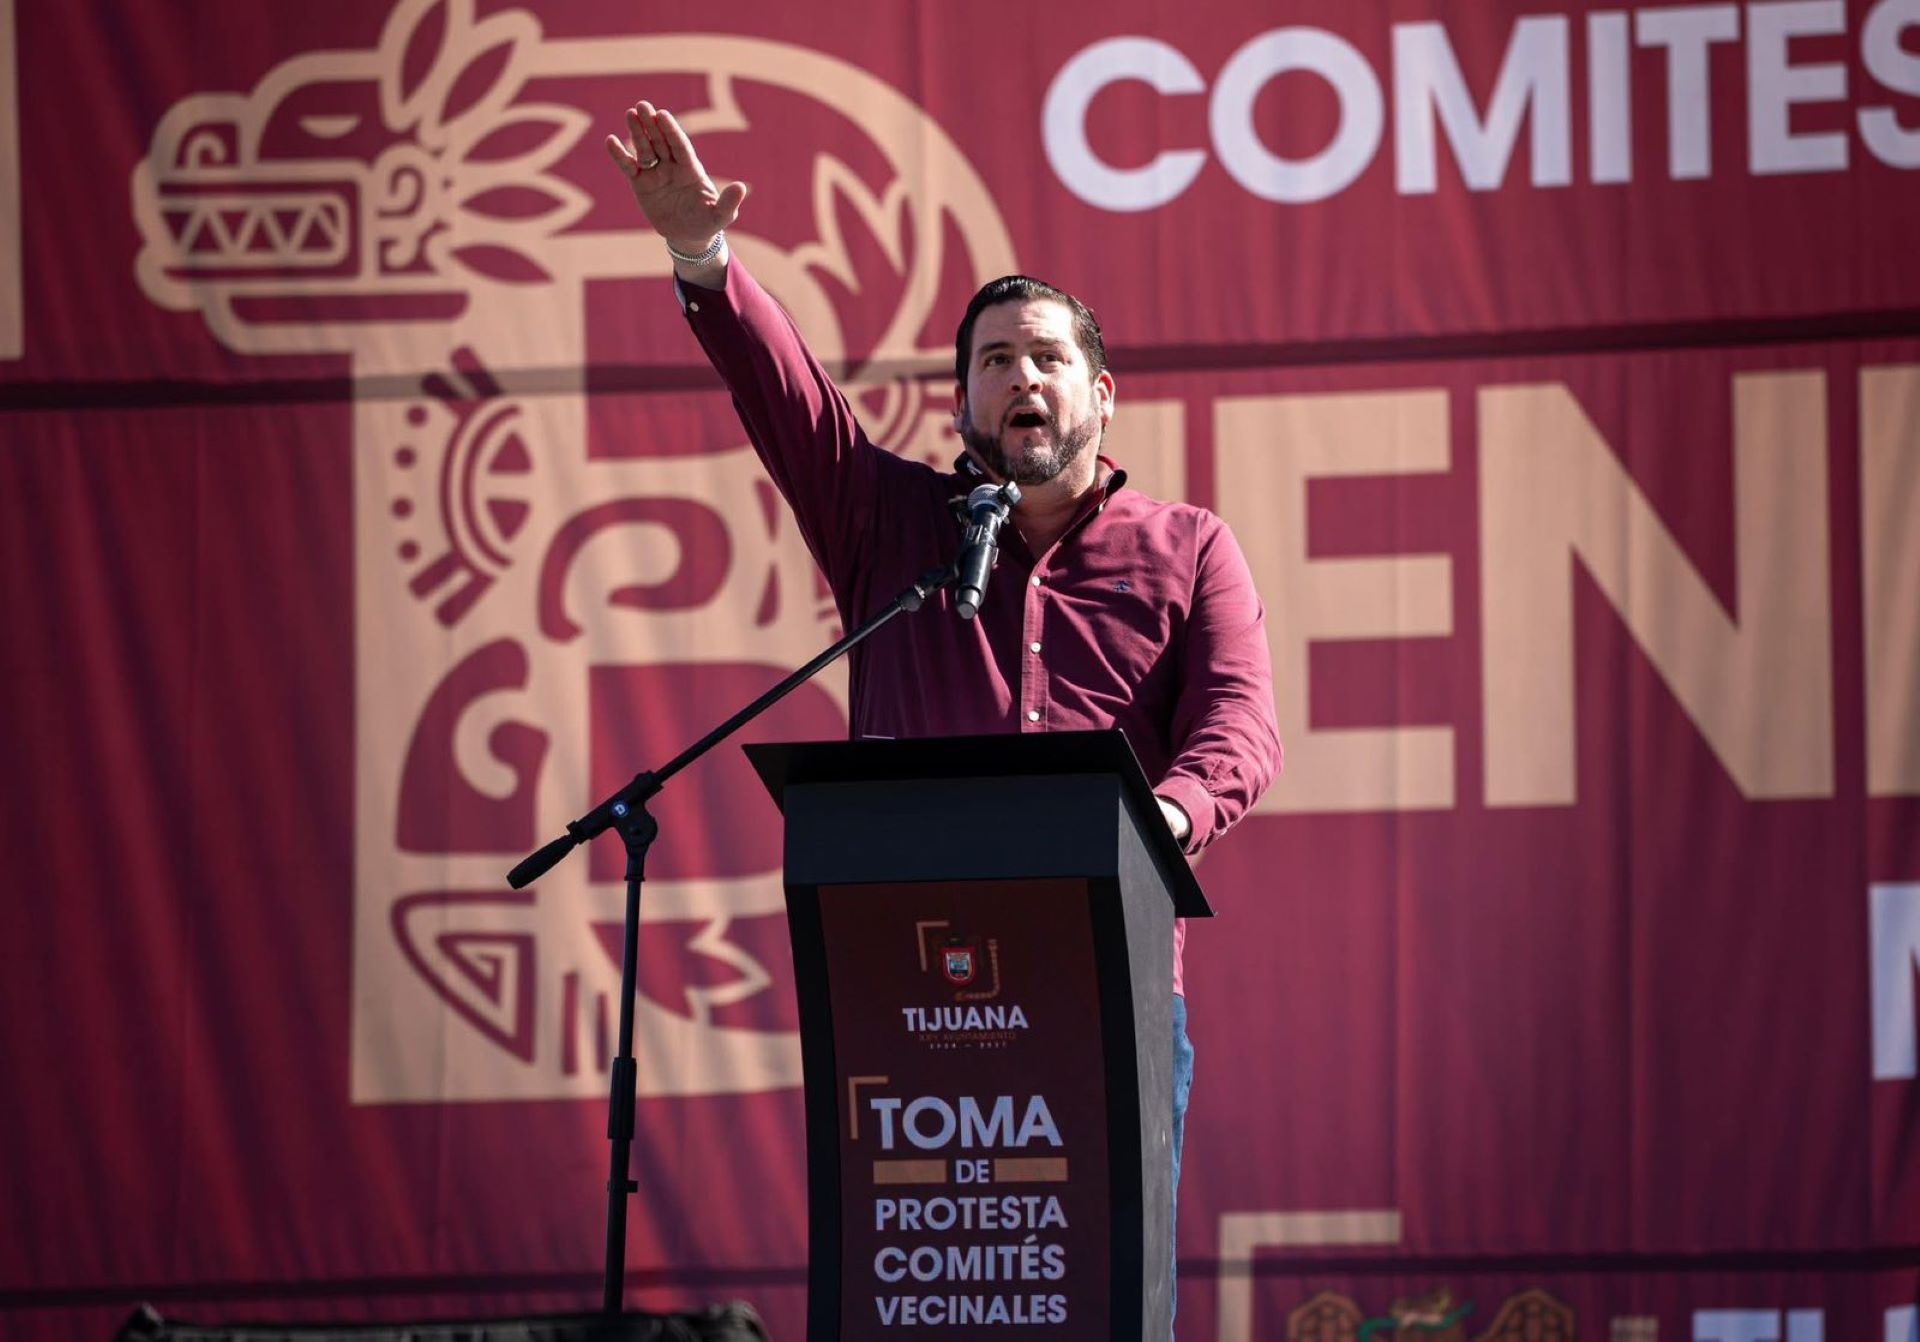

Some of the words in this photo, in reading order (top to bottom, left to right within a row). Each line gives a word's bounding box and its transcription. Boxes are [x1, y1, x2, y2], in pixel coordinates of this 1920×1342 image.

[902, 1005, 1029, 1032] TIJUANA
[870, 1095, 1063, 1149] TOMA
[955, 1159, 990, 1184] DE
[875, 1195, 1069, 1231] PROTESTA
[874, 1234, 1066, 1283] COMITÉS
[875, 1294, 1068, 1326] VECINALES
